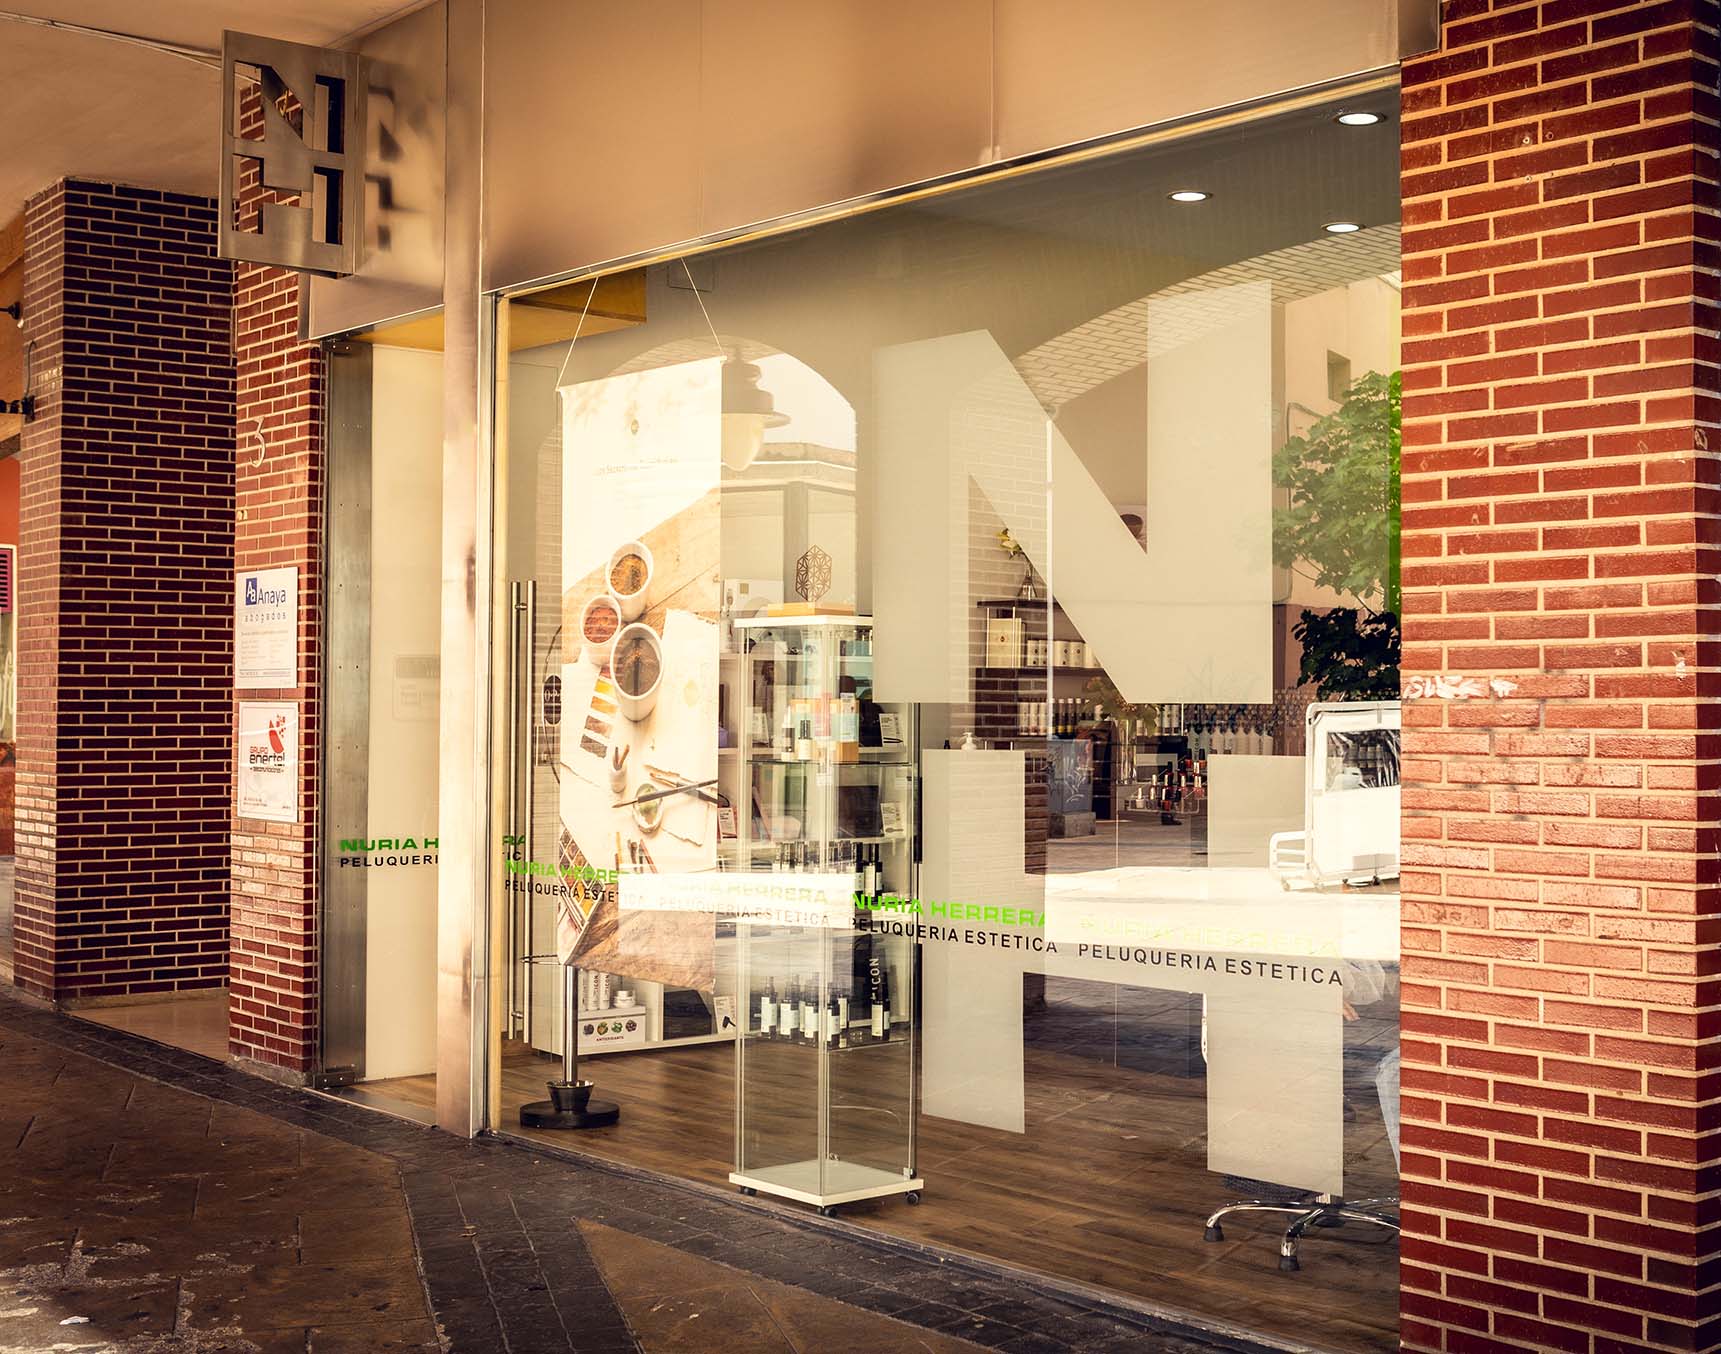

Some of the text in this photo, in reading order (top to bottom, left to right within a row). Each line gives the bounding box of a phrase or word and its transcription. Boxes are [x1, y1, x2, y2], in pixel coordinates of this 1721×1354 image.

[249, 415, 266, 469] 3
[872, 279, 1273, 704] N
[258, 588, 286, 607] Anaya
[339, 838, 418, 852] NURIA
[340, 854, 438, 868] PELUQUERI
[504, 859, 627, 884] NURIA HERRE
[504, 879, 624, 903] PELUQUERIA ESTE
[852, 893, 924, 916] NURIA
[965, 930, 1057, 953] ESTETICA
[869, 958, 881, 990] ICON
[1078, 943, 1343, 987] PELUQUERIA ESTETICA
